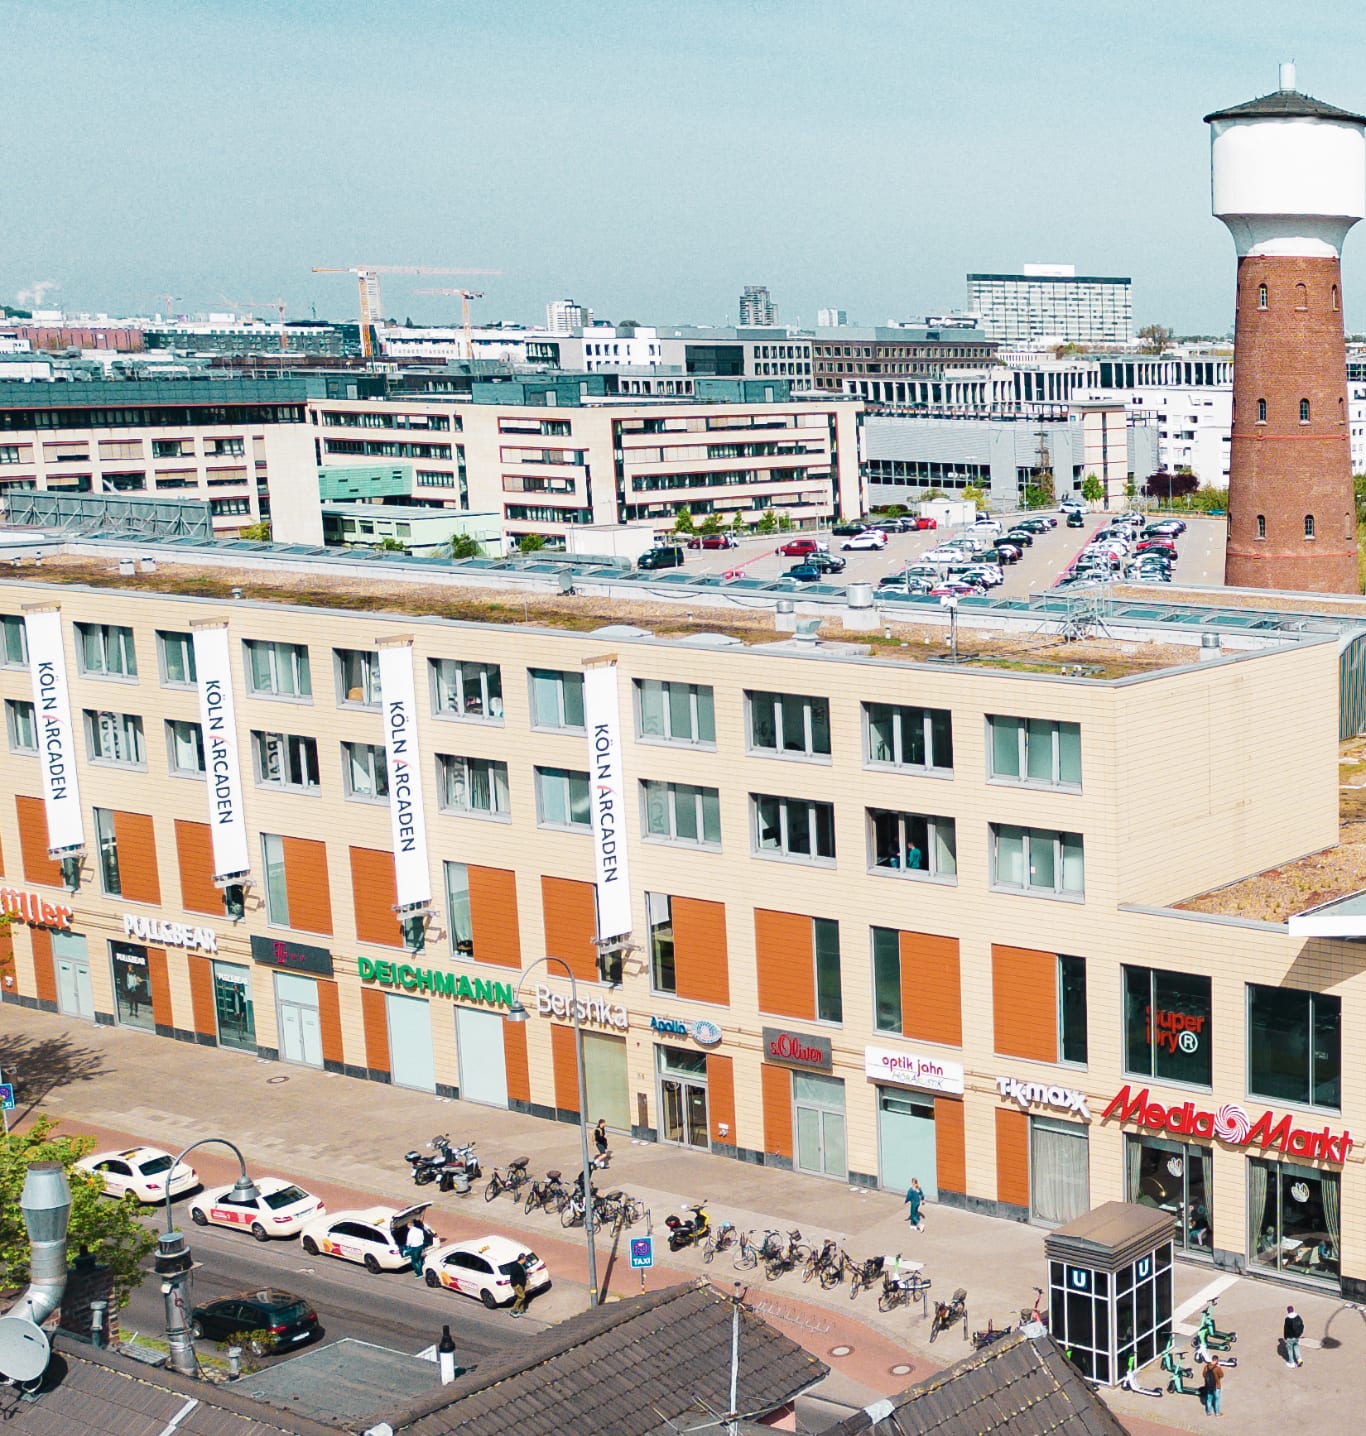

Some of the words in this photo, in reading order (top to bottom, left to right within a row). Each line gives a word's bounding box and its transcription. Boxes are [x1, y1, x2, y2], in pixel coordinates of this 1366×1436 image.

[38, 661, 59, 711] KÖLN
[205, 679, 226, 730] KÖLN
[389, 701, 409, 754] KÖLN
[594, 724, 614, 779] KÖLN
[42, 714, 68, 801] ARCADEN
[209, 735, 234, 825] ARCADEN
[392, 758, 416, 853] ARCADEN
[596, 784, 618, 883] ARCADEN
[0, 887, 71, 929] üller
[357, 956, 514, 1006] DEICHMANN
[535, 984, 629, 1028] Bershka
[881, 1055, 913, 1072] optik
[916, 1058, 944, 1077] jahn
[1100, 1085, 1217, 1139] Media
[1243, 1110, 1354, 1165] Markt
[632, 1257, 651, 1266] TAXI
[1072, 1270, 1088, 1287] U
[1138, 1257, 1150, 1277] U
